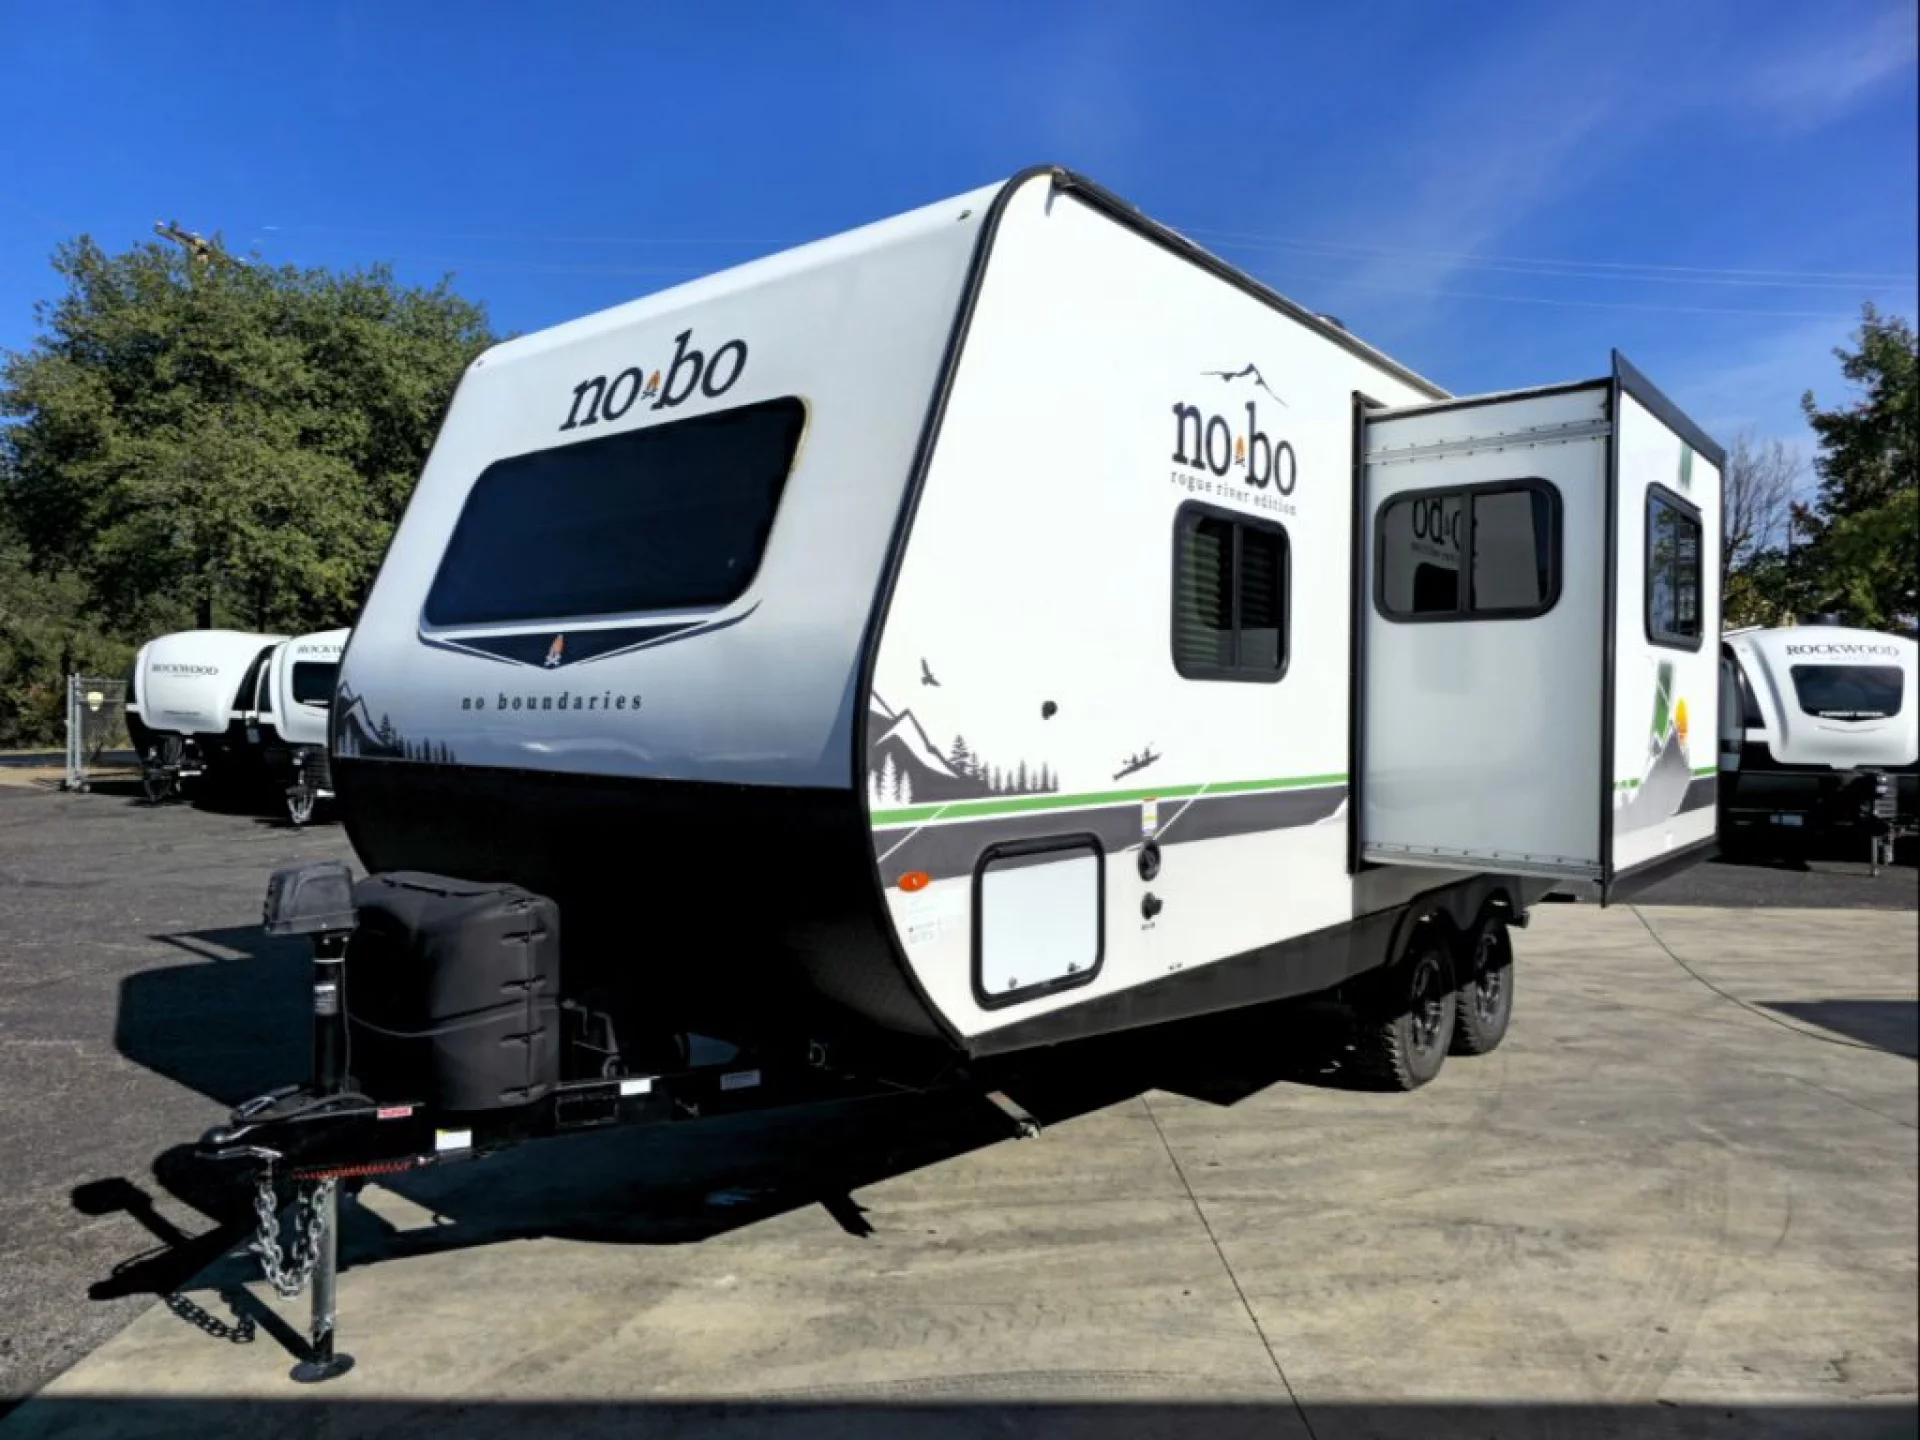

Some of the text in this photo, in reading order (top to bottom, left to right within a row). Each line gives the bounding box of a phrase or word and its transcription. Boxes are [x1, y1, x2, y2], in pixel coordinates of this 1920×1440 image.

[1171, 471, 1297, 517] rogue river edition
[1785, 644, 1900, 656] ROCKWOOD
[462, 691, 643, 711] no boundaries
